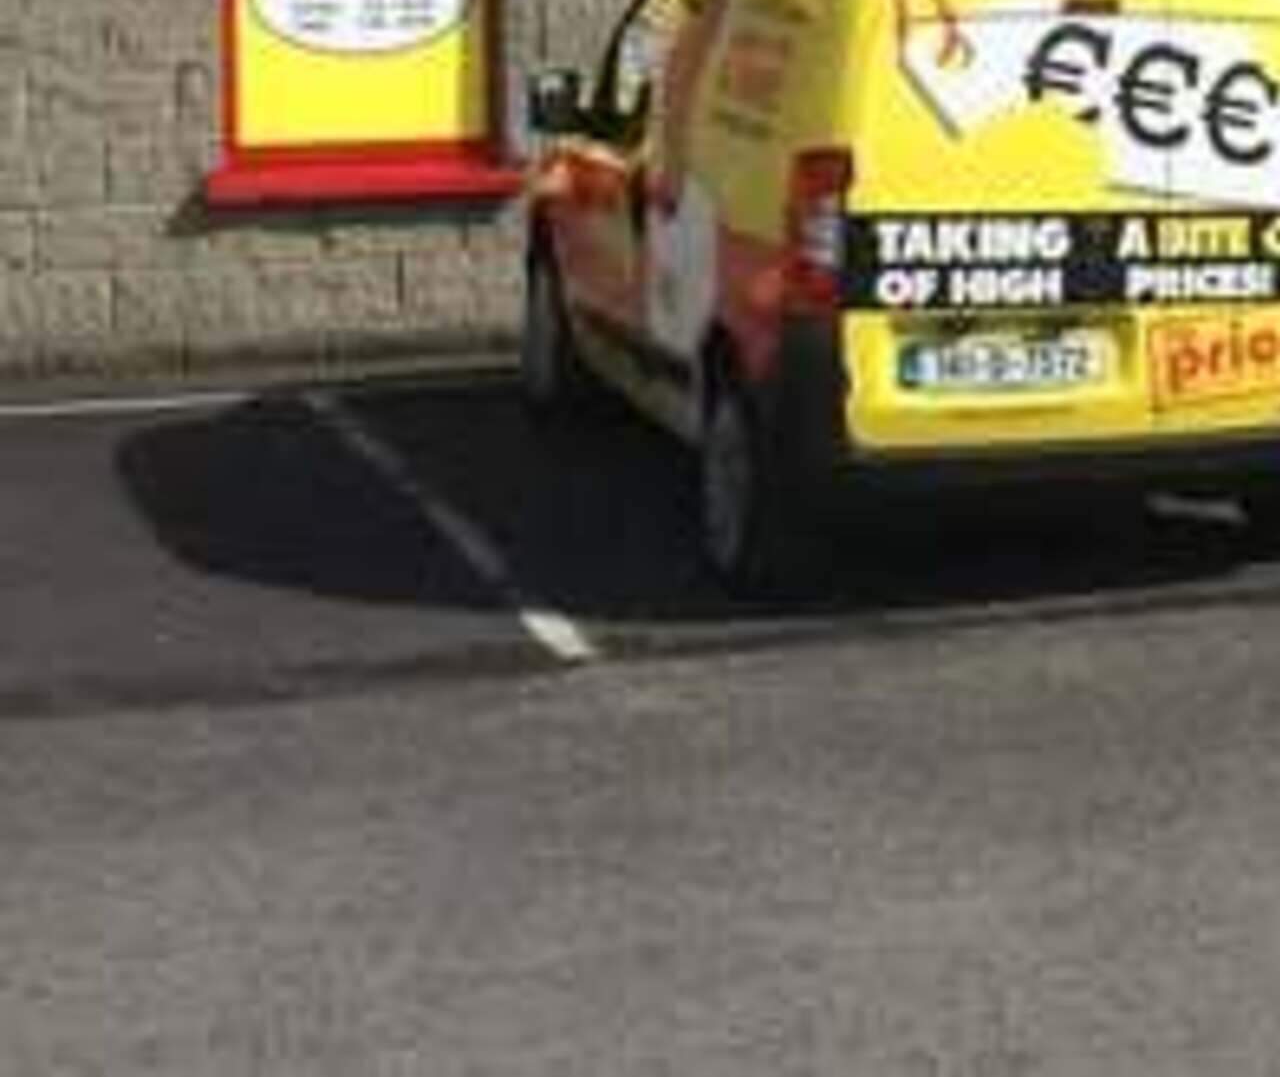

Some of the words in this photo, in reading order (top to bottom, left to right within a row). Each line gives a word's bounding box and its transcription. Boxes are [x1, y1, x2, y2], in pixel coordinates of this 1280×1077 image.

[876, 218, 1071, 264] TAKING
[1117, 218, 1152, 259] A
[1157, 217, 1250, 259] BITE
[876, 269, 938, 305] OF
[950, 269, 1064, 305] HIGH
